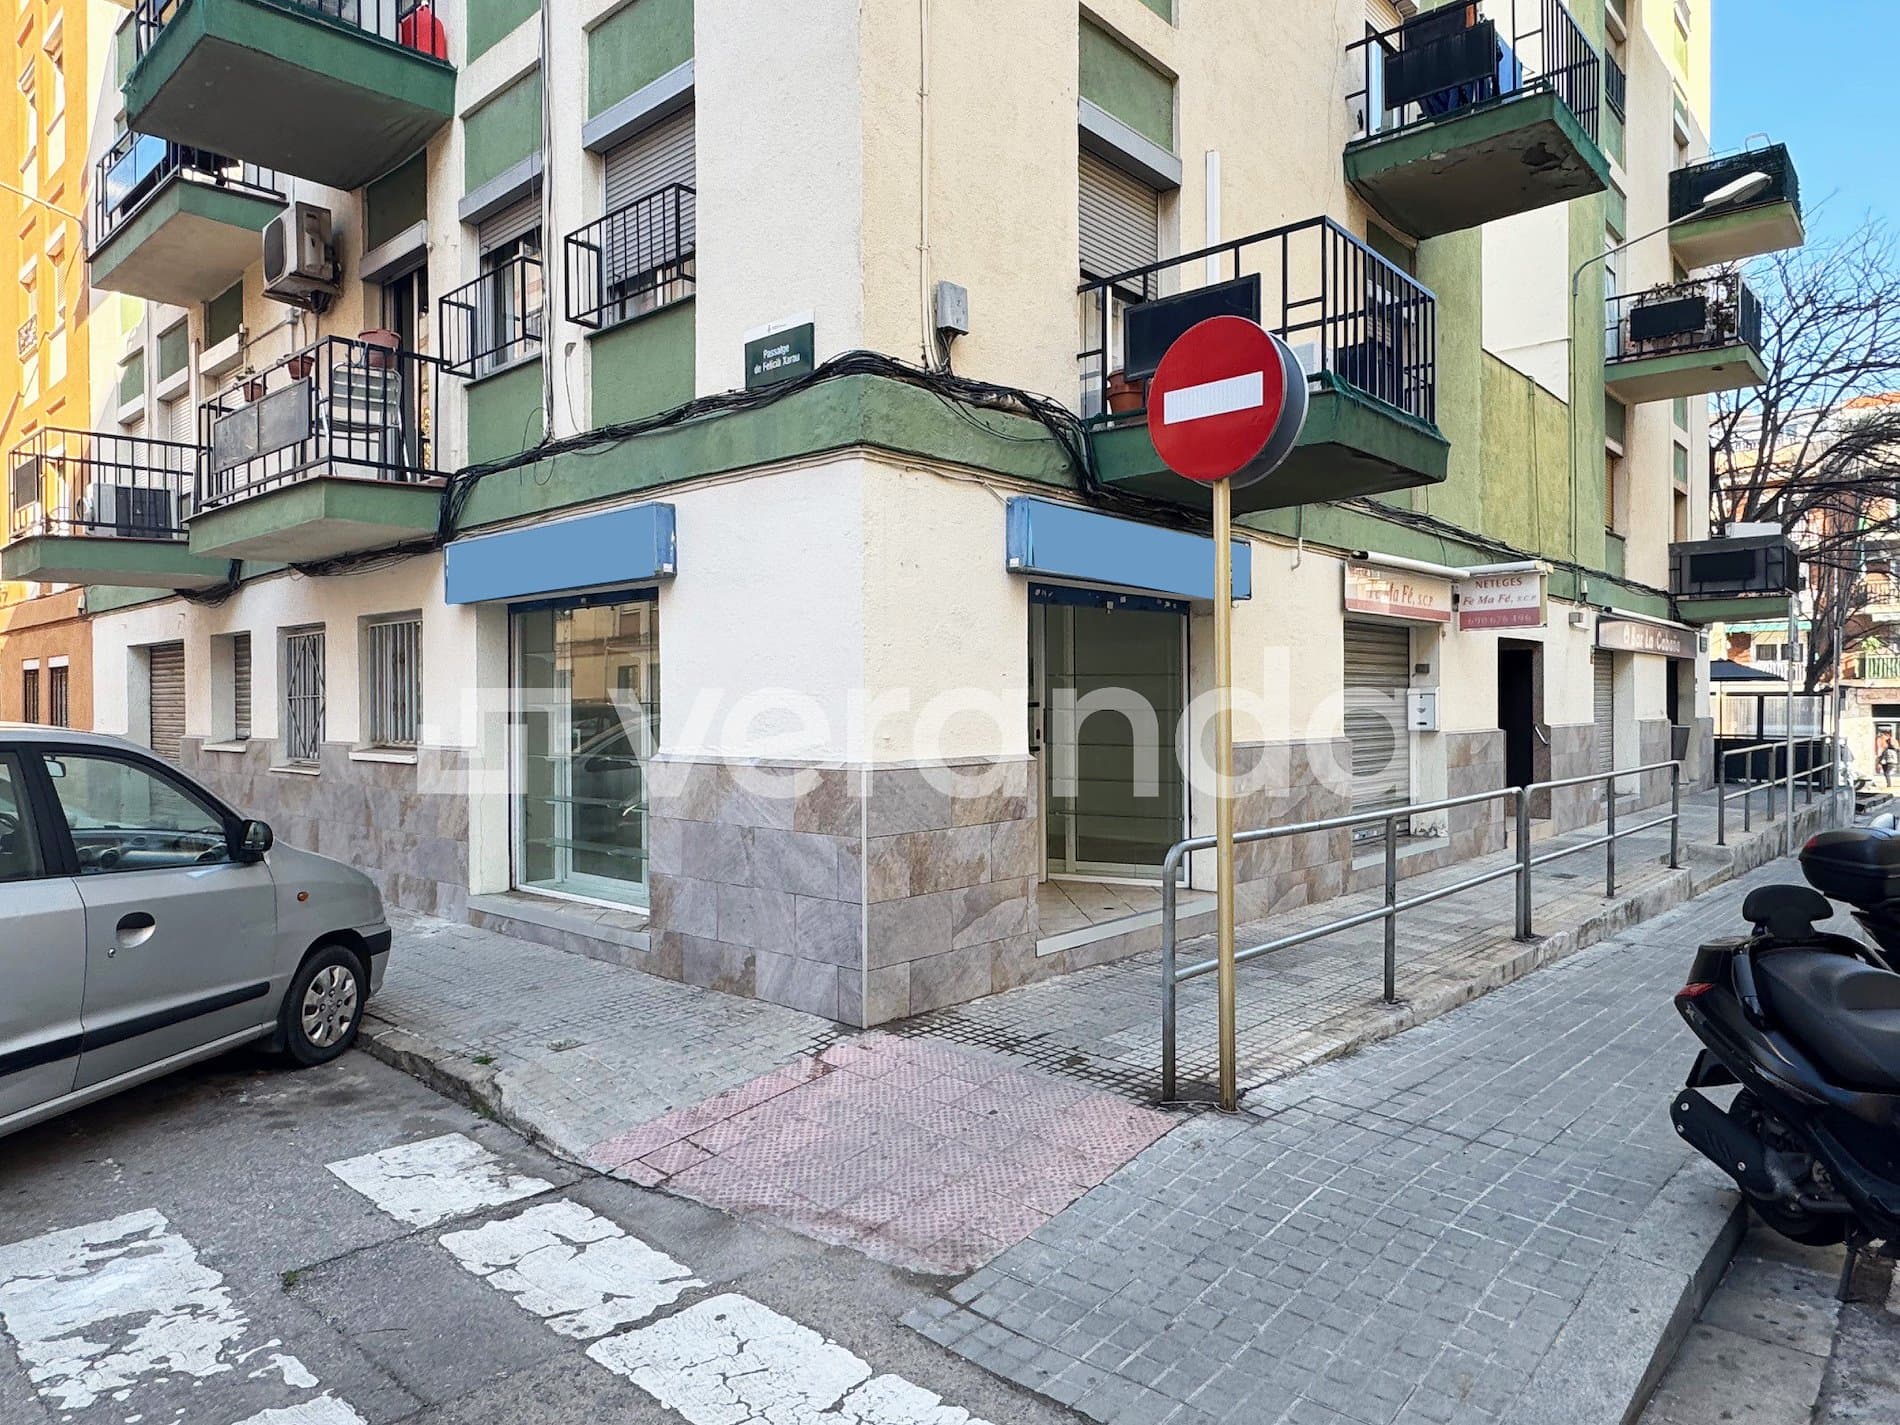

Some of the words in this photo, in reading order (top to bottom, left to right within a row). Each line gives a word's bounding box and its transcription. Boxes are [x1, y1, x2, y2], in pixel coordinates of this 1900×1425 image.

[754, 363, 762, 375] de
[1463, 596, 1474, 606] Fe
[1478, 593, 1495, 605] Ma
